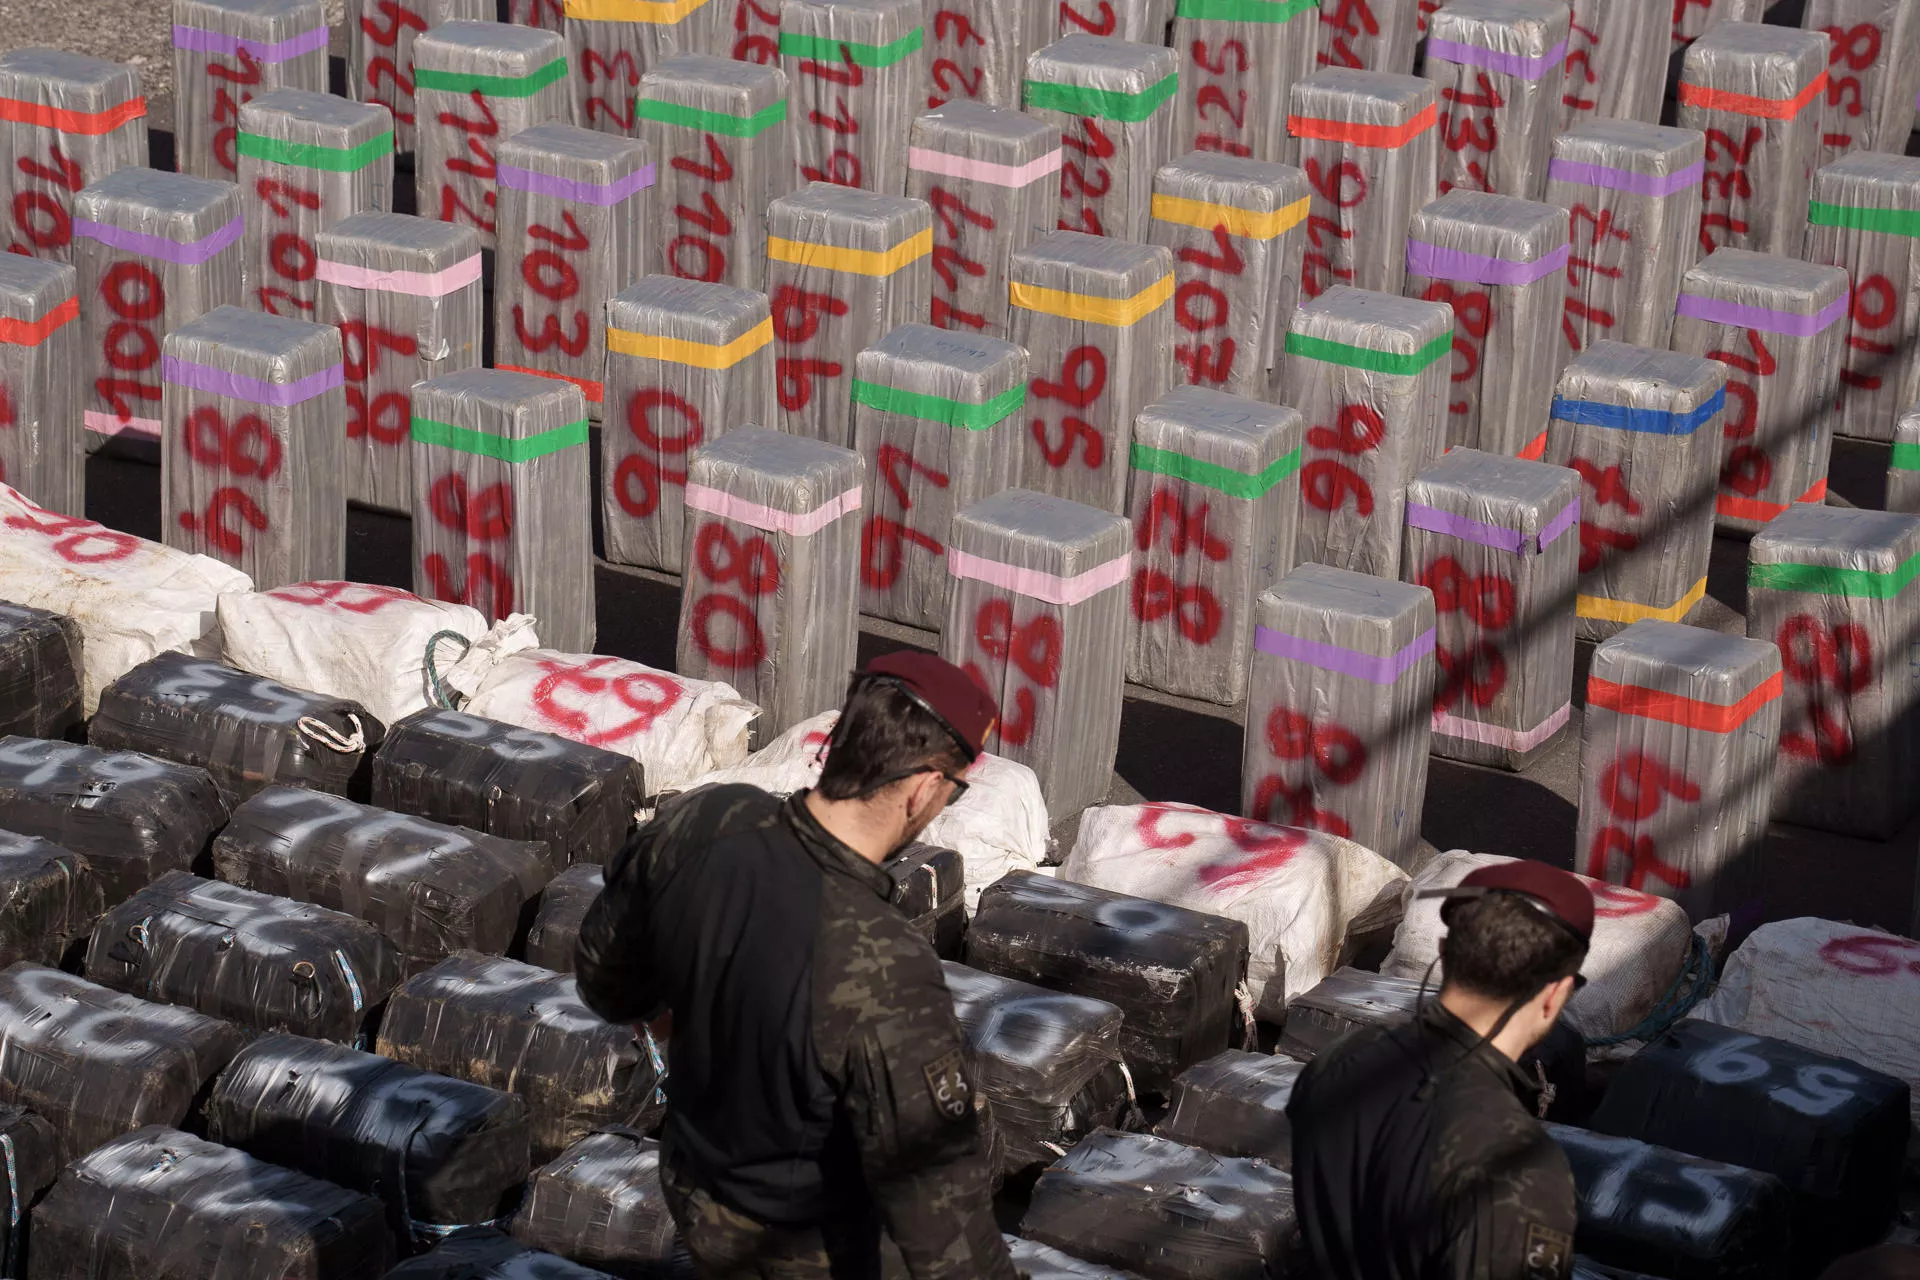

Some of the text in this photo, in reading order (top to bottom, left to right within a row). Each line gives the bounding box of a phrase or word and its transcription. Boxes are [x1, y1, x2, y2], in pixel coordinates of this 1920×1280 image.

[927, 10, 986, 108] 27
[12, 144, 83, 256] 10
[94, 261, 166, 424] 100
[508, 210, 592, 357] 103
[1174, 224, 1259, 385] 107
[1028, 344, 1107, 469] 95
[1299, 402, 1387, 518] 96
[859, 442, 950, 592] 91
[688, 520, 782, 669] 80
